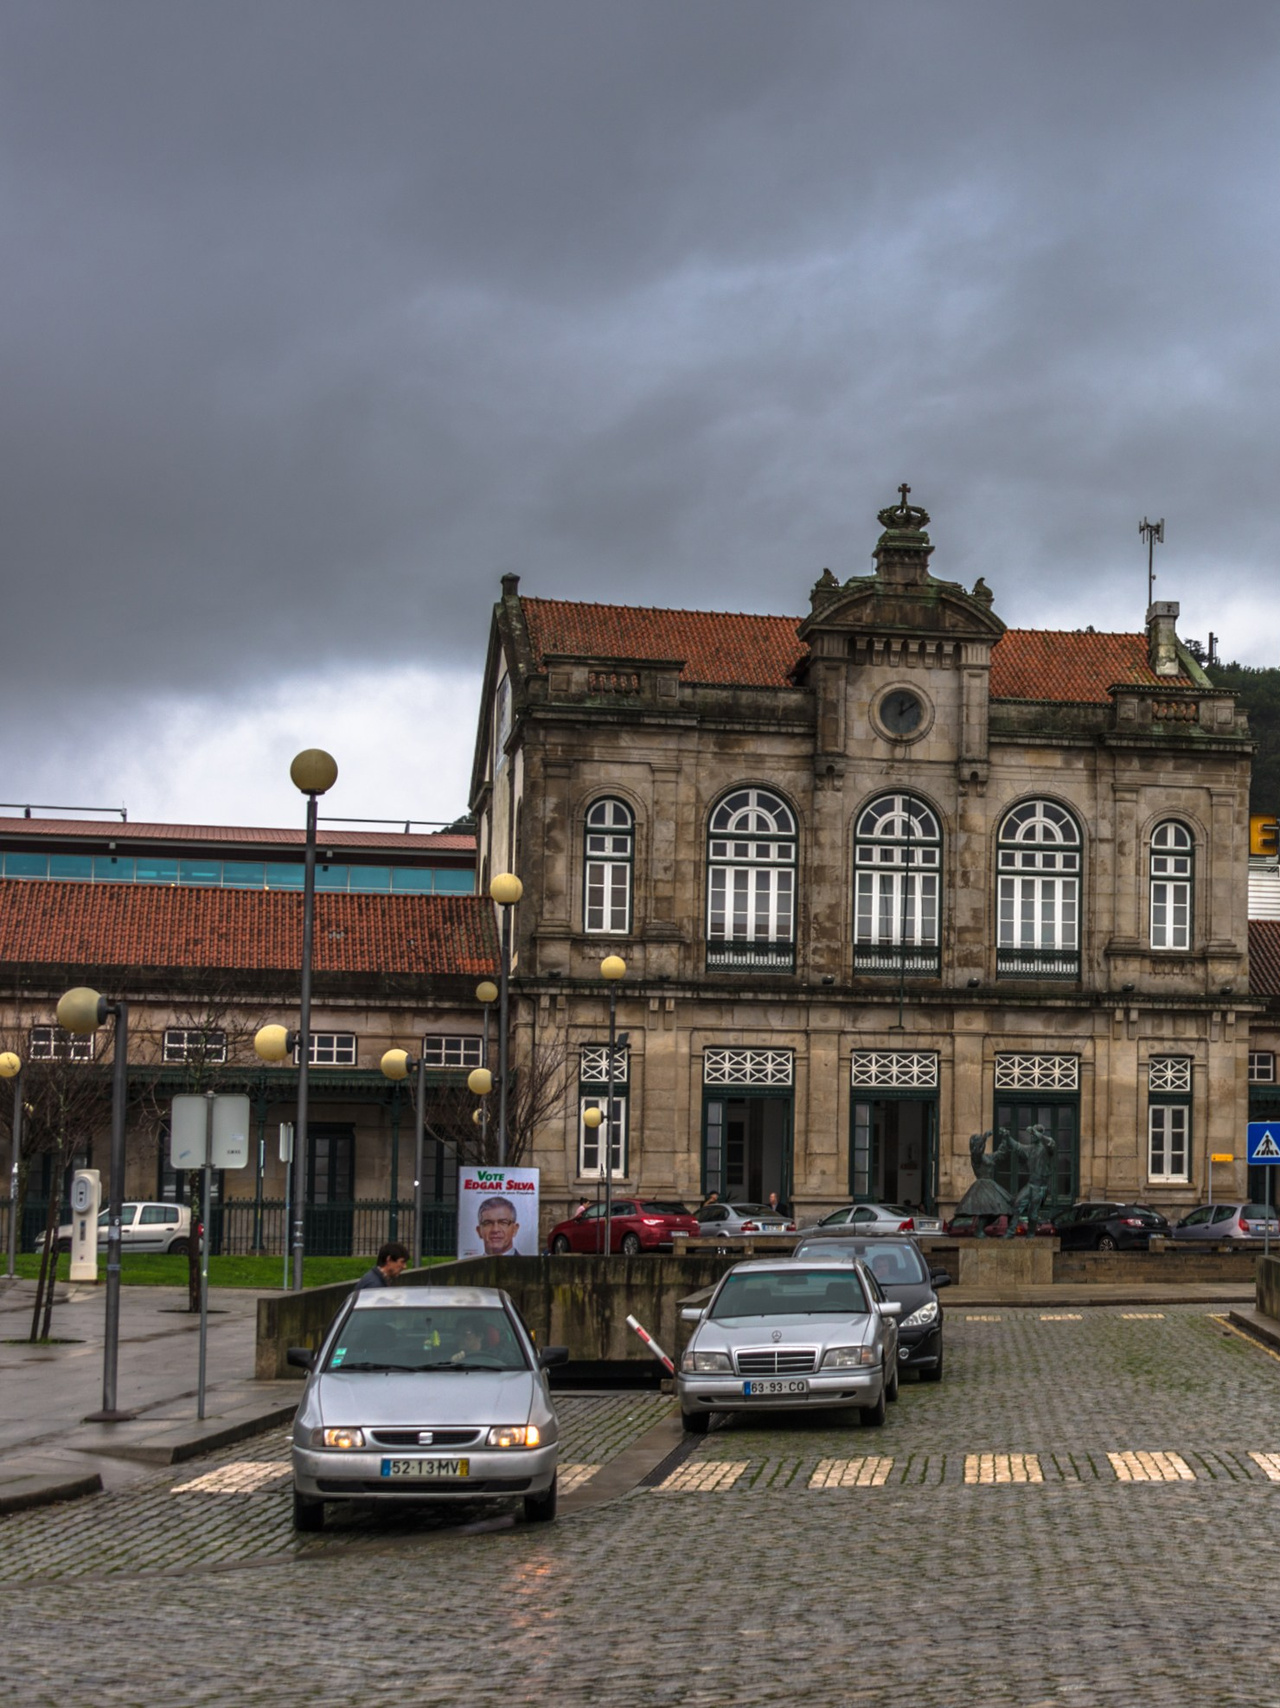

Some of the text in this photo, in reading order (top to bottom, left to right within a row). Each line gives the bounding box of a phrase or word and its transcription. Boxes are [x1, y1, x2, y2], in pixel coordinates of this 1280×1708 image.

[477, 1171, 505, 1181] VOTE
[464, 1179, 535, 1191] EDGAR SILVA
